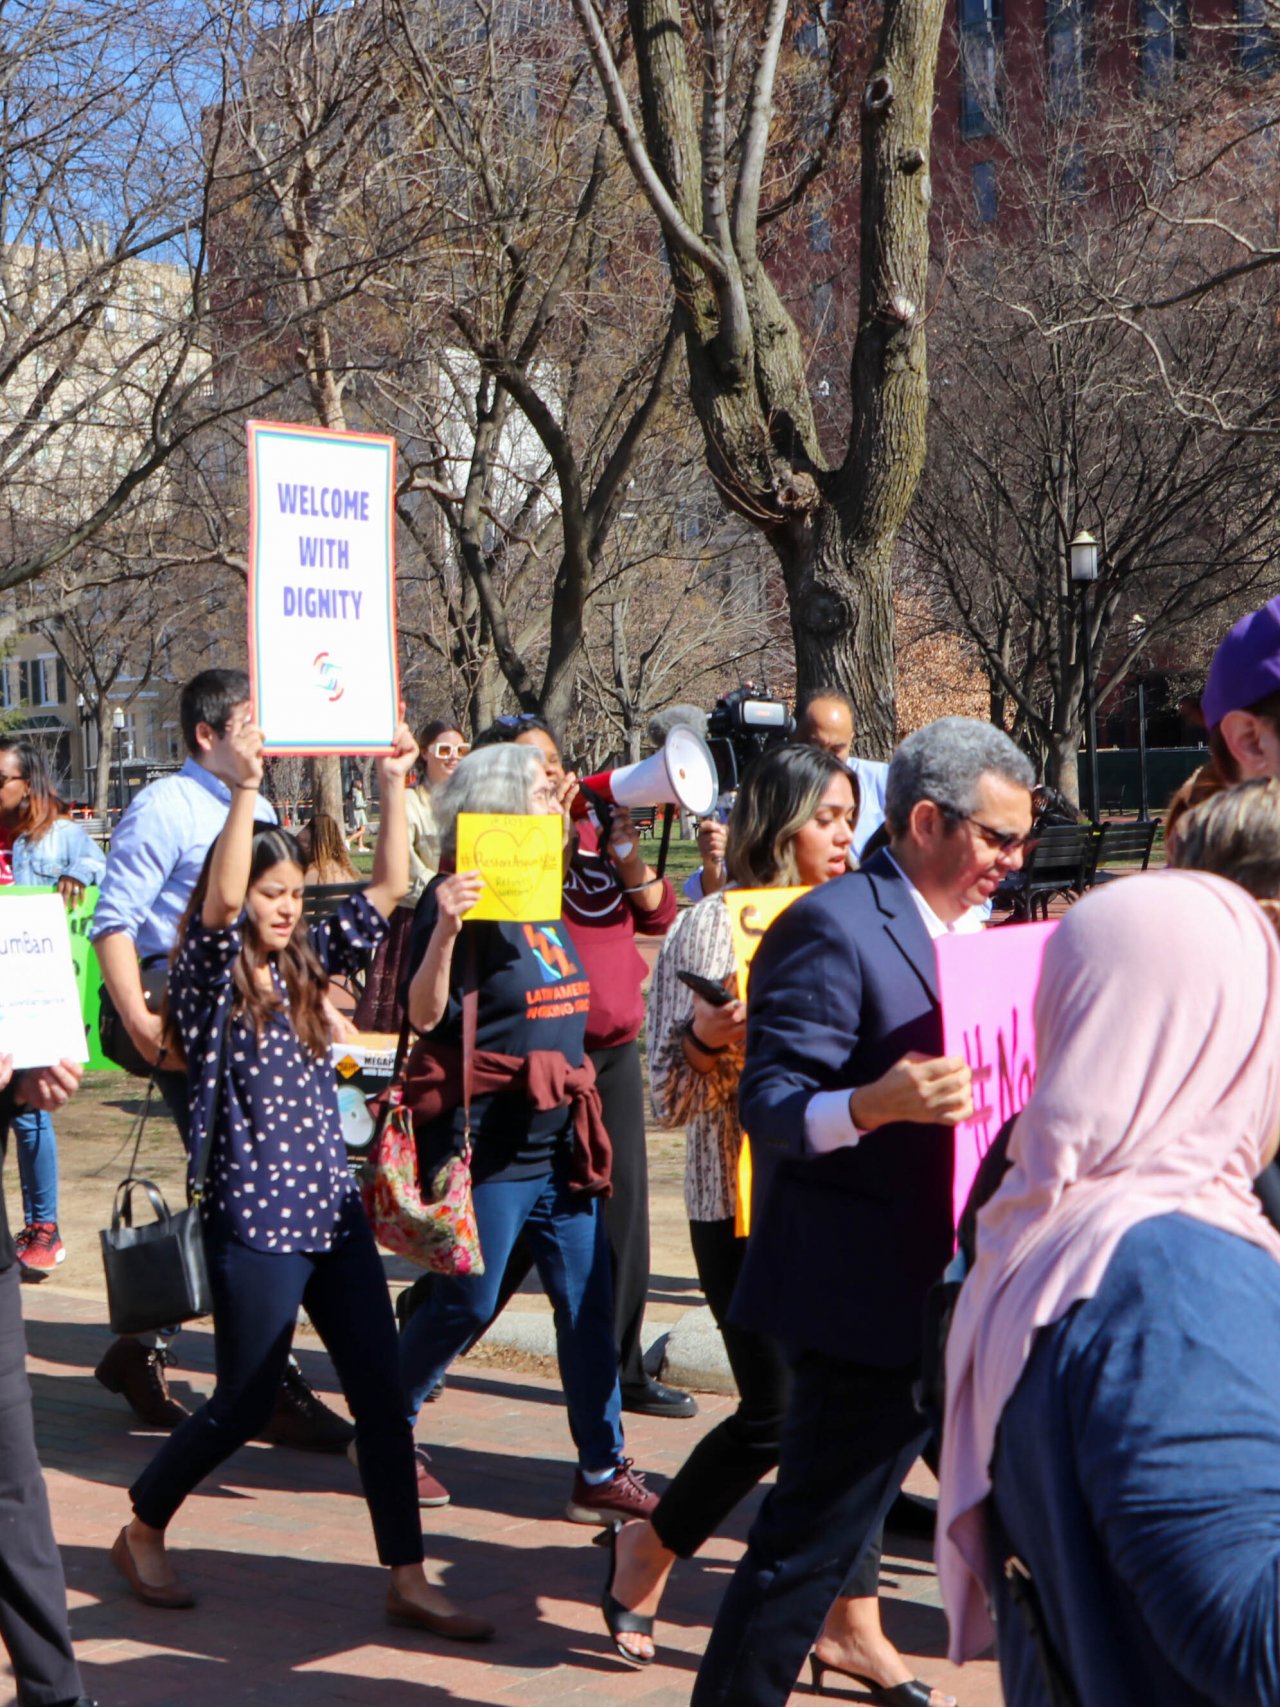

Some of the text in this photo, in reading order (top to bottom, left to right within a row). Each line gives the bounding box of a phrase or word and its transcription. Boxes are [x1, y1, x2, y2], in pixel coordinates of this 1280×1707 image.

[277, 482, 369, 521] WELCOME
[298, 536, 350, 569] WITH
[283, 586, 363, 620] DIGNITY
[364, 1056, 395, 1067] MEGAP
